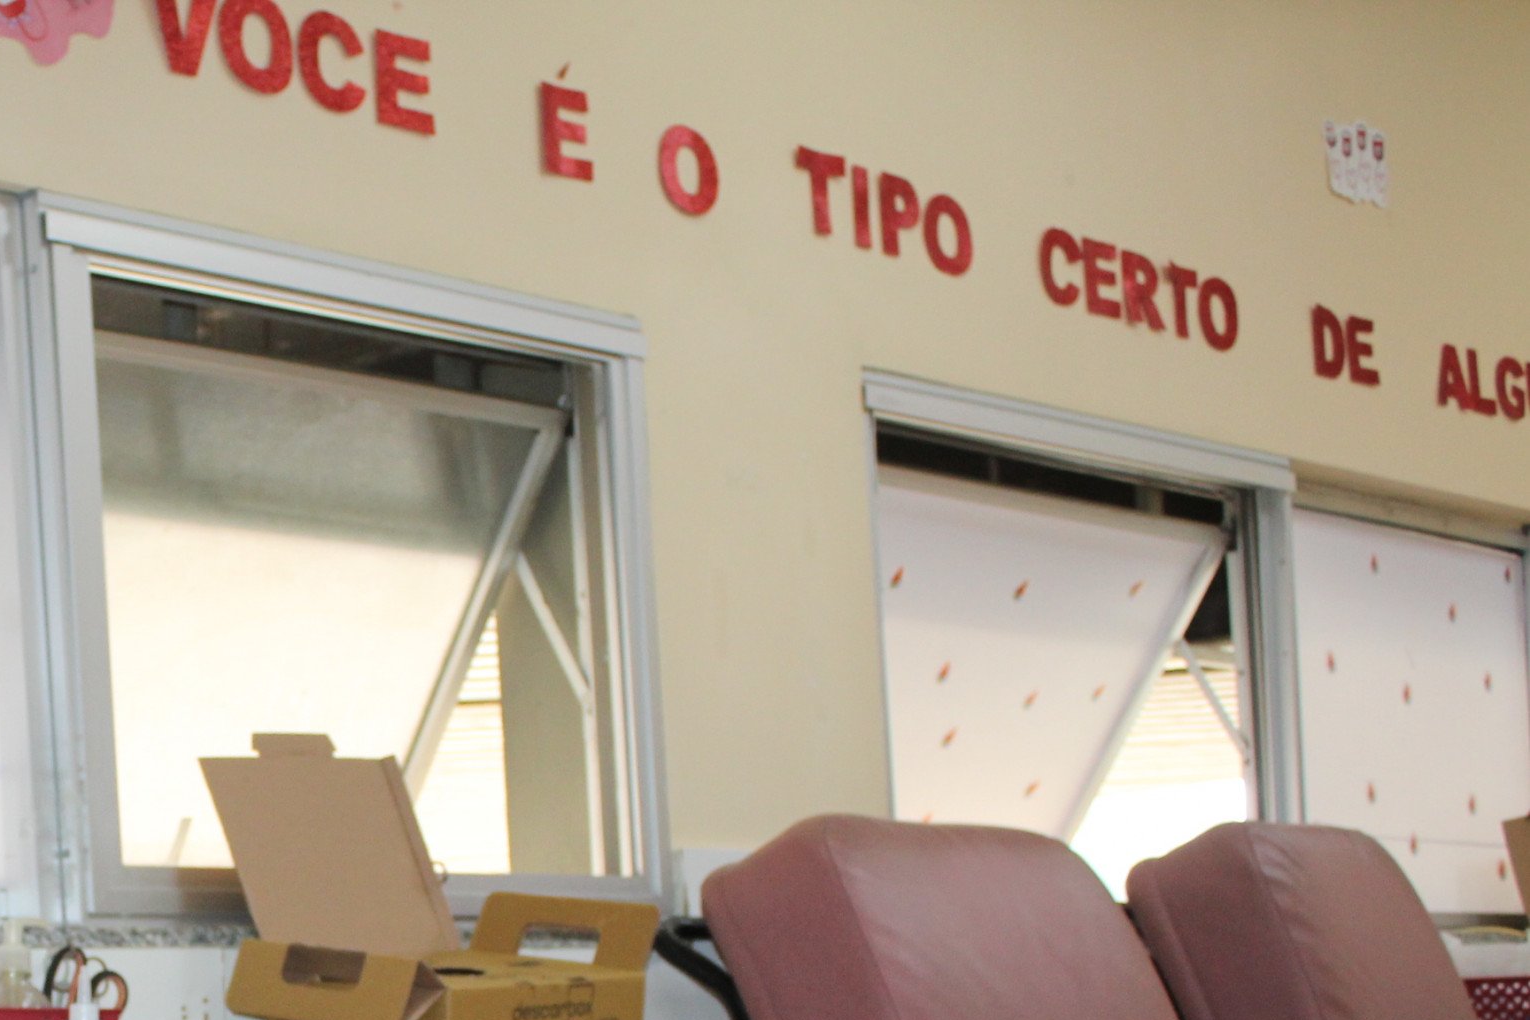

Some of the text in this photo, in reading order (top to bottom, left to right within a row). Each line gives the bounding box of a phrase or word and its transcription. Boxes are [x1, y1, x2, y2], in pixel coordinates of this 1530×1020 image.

[540, 62, 594, 182] É
[658, 124, 720, 217] O
[795, 146, 973, 277] TIPO
[1039, 228, 1238, 352] CERTO
[1311, 305, 1380, 387] DE
[1437, 343, 1530, 421] ALG
